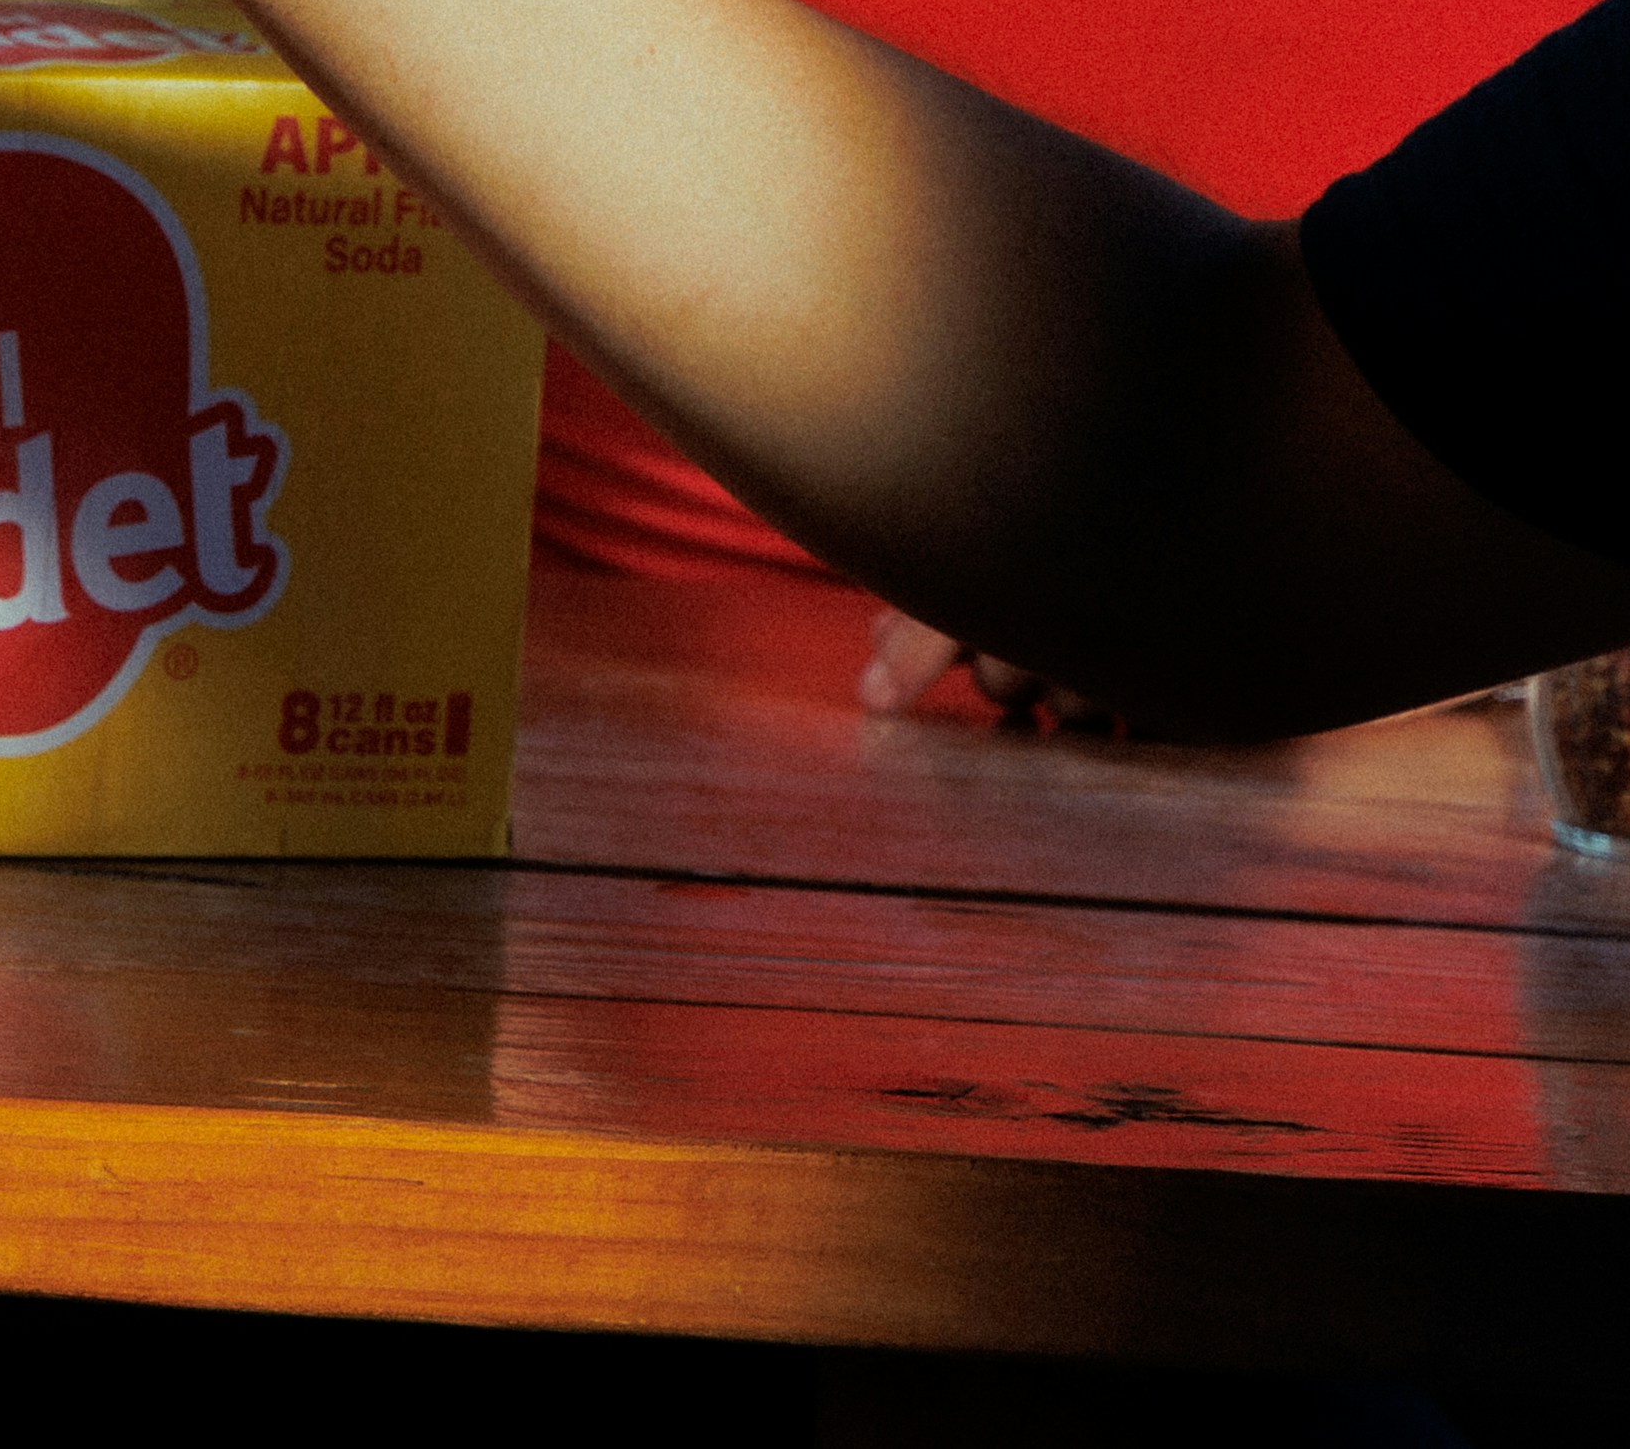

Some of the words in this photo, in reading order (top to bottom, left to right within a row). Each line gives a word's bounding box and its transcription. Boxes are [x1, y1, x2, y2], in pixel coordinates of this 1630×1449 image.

[240, 188, 383, 226] Natural
[323, 235, 424, 275] Soda
[279, 690, 321, 755] 8
[329, 693, 365, 723] 12
[326, 728, 437, 757] cans
